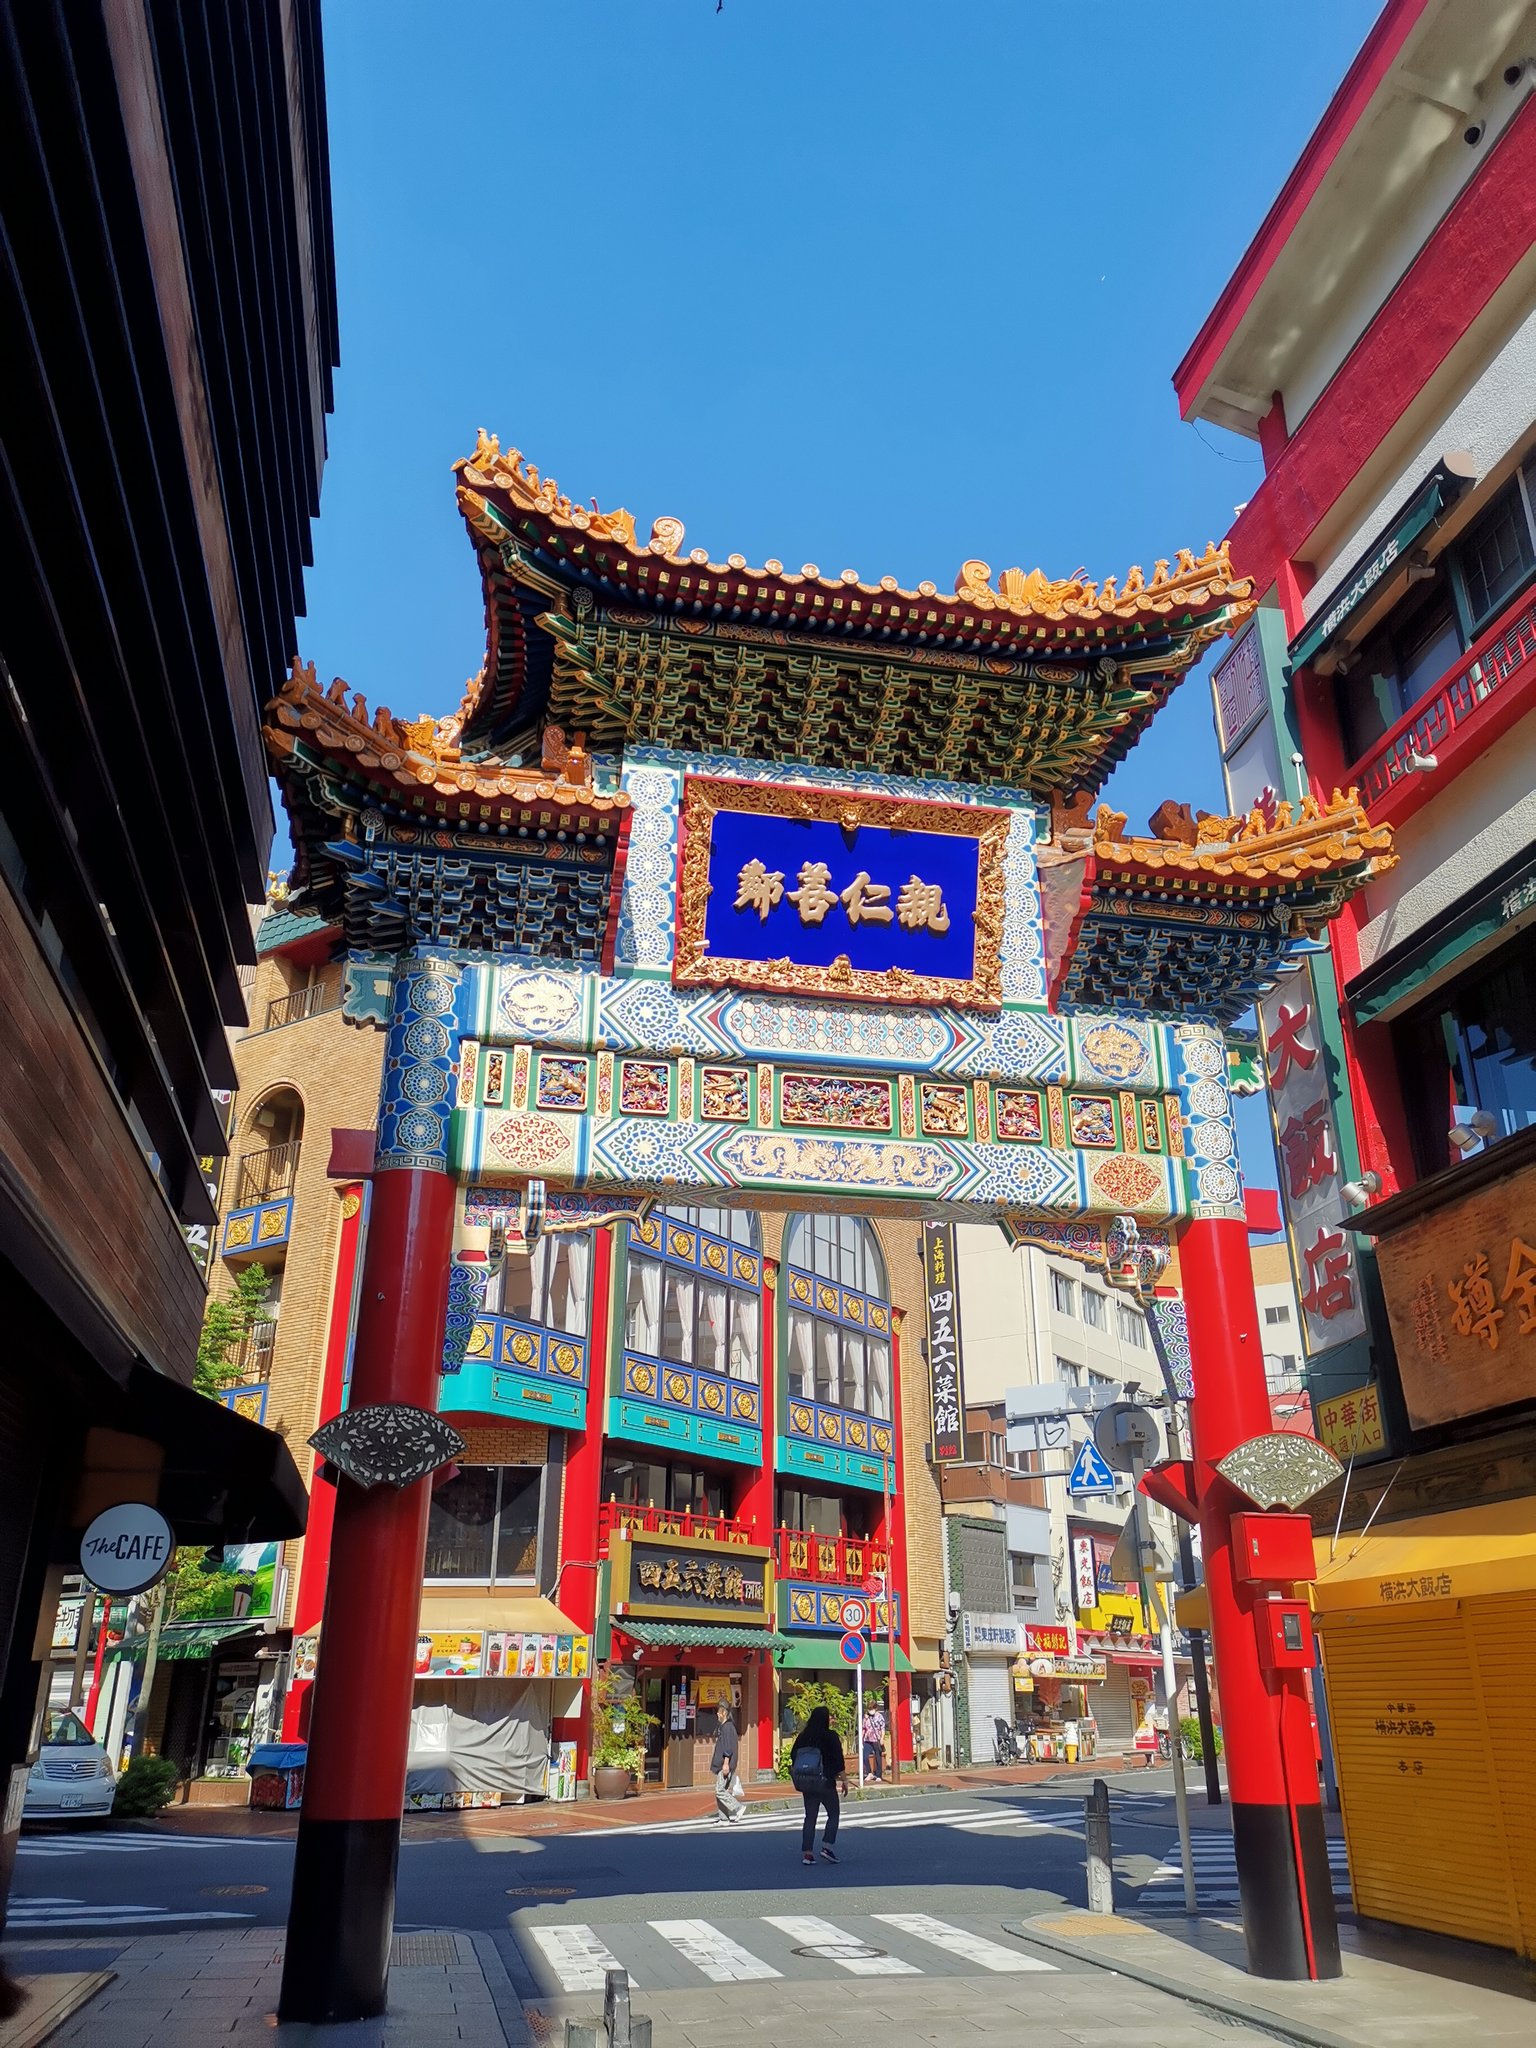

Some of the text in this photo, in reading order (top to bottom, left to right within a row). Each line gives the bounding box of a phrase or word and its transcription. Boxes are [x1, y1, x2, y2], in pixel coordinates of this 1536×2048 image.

[1321, 538, 1399, 637] 横浜大飯店
[933, 1236, 946, 1284] 上海料理
[929, 1290, 959, 1434] 四五六菜館
[1323, 1394, 1378, 1434] 中華街
[86, 1534, 165, 1560] The CAFE
[636, 1558, 743, 1600] 四五六菜館
[1079, 1540, 1093, 1605] 東光飯店
[1379, 1573, 1453, 1601] 横浜大飯店
[845, 1608, 861, 1622] 30
[1375, 1718, 1436, 1737] 横浜大飯店
